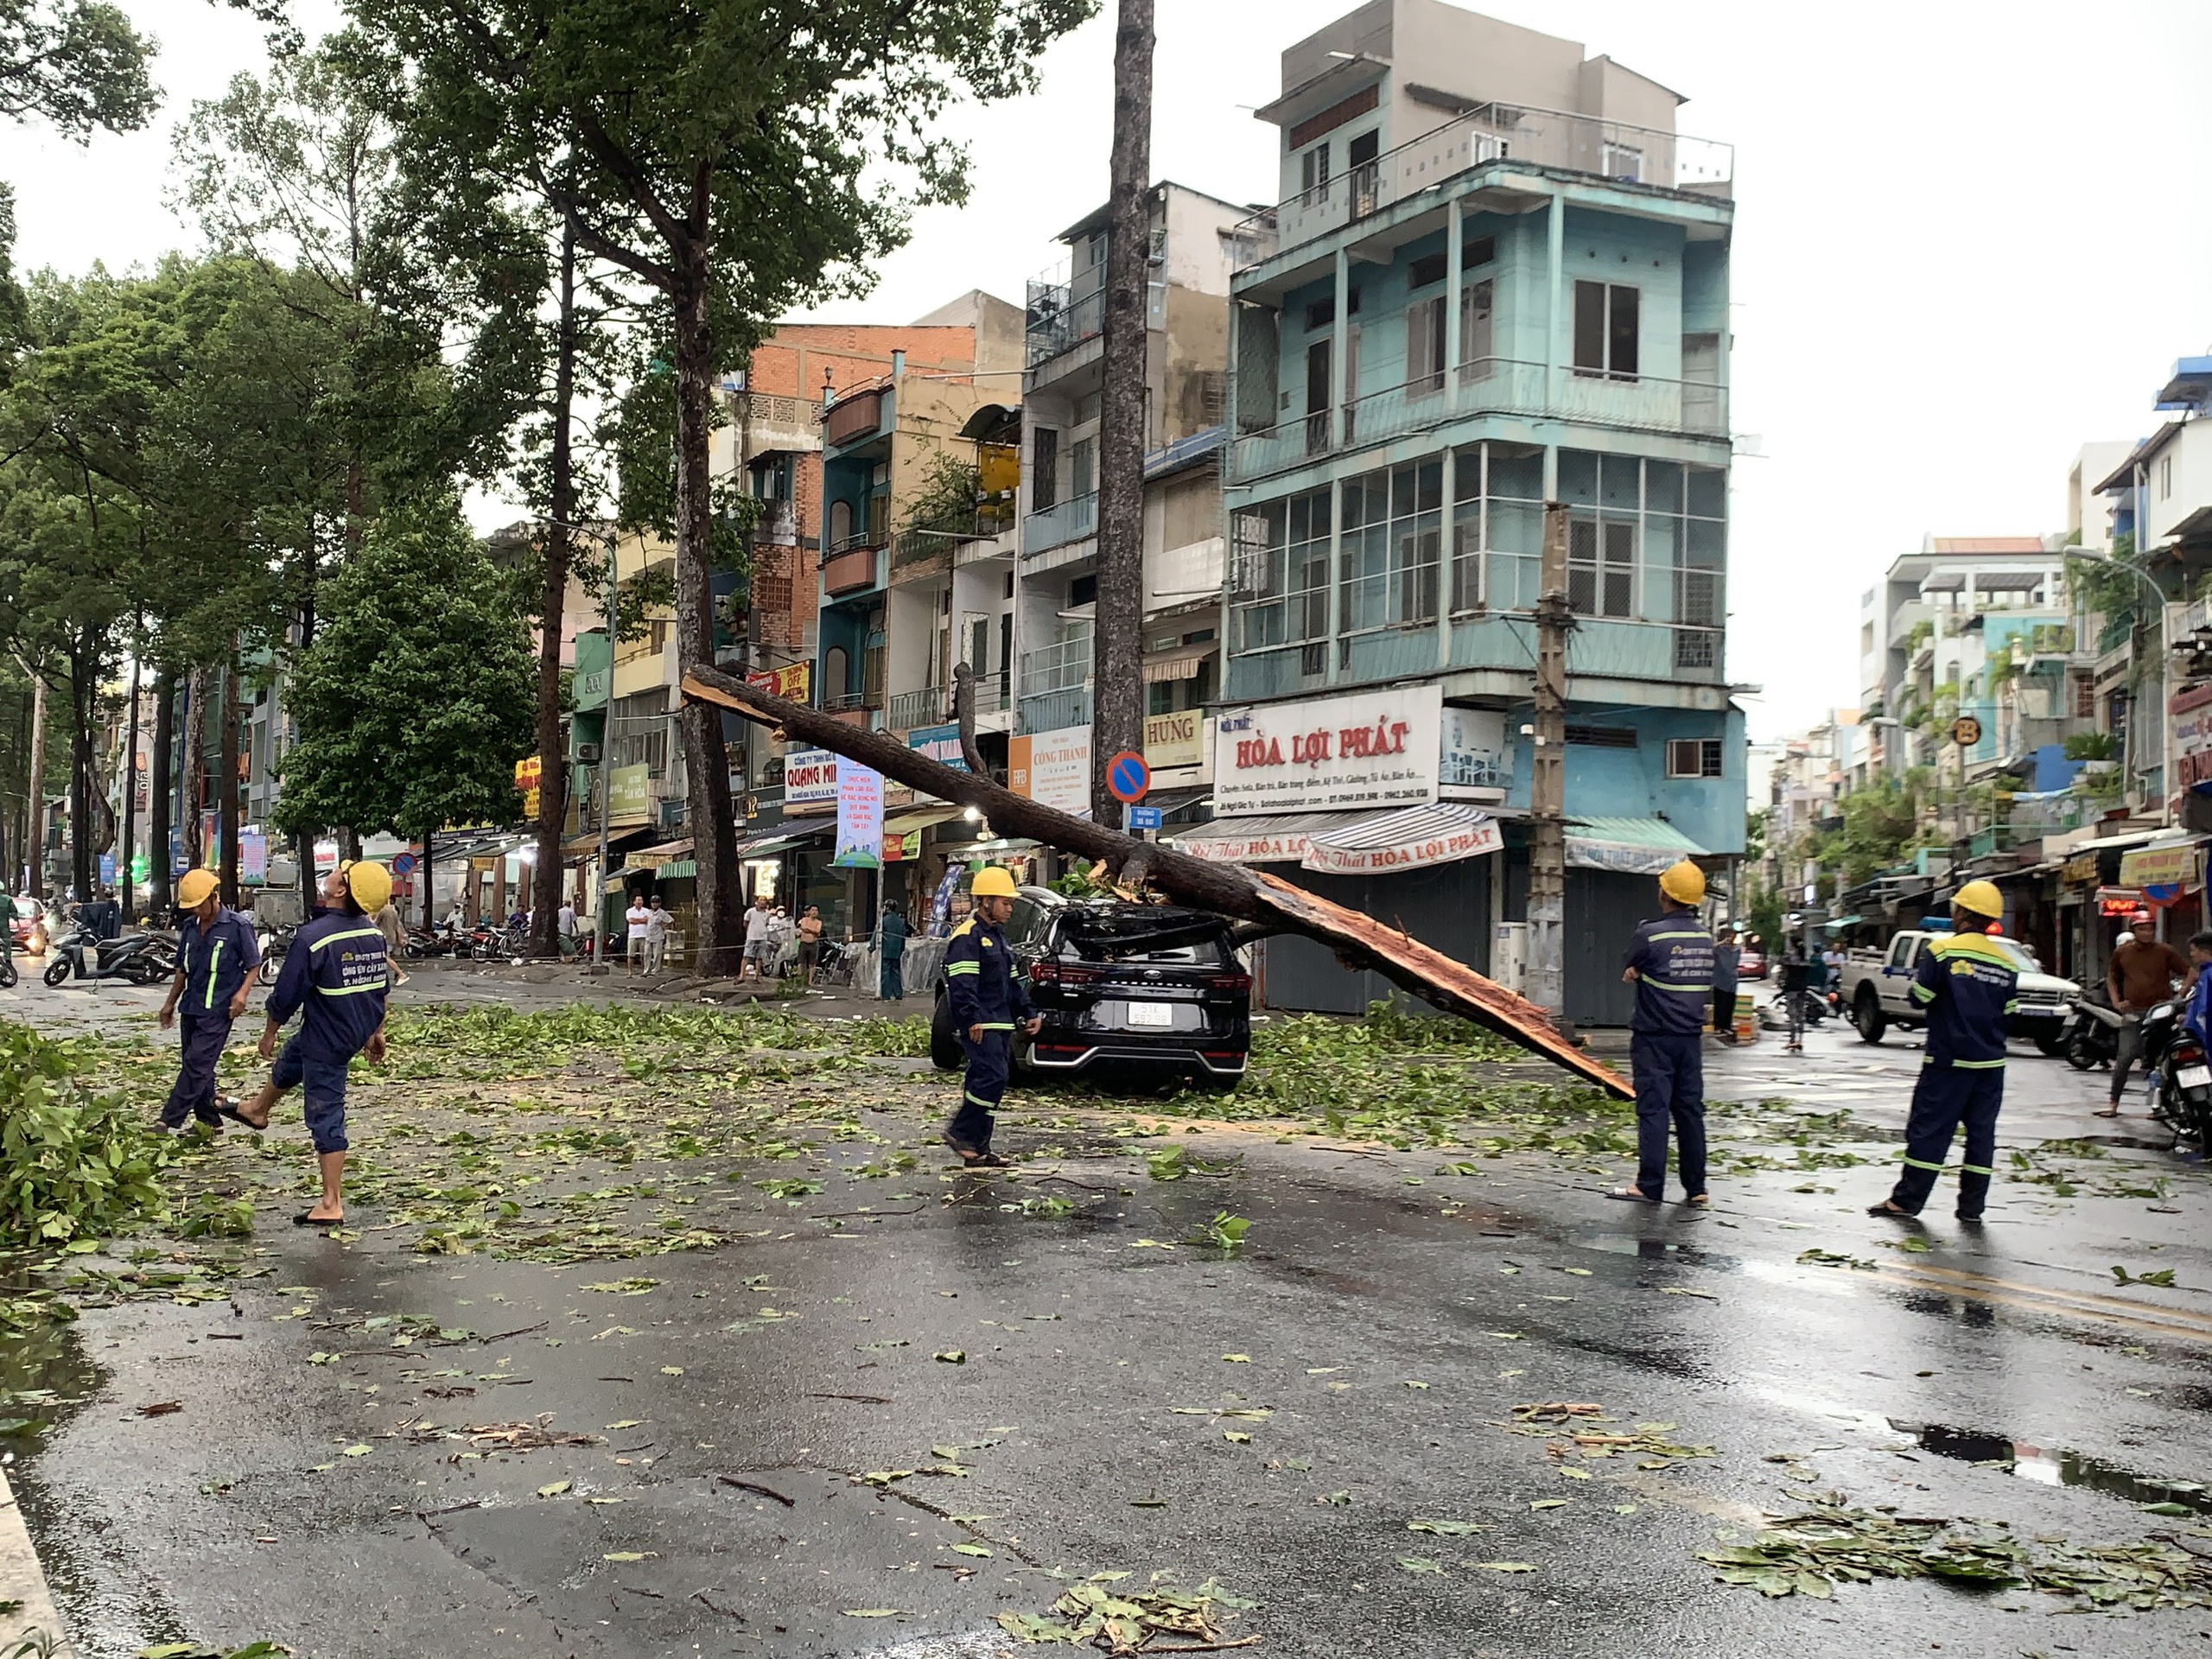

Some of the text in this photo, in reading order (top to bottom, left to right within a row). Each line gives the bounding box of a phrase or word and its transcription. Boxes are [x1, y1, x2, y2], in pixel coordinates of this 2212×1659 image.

[1236, 715, 1410, 770] HÒA LỢI PHÁT
[787, 765, 820, 788] QUANG
[1371, 847, 1410, 867] HÒA
[1448, 828, 1491, 853] PHÁT
